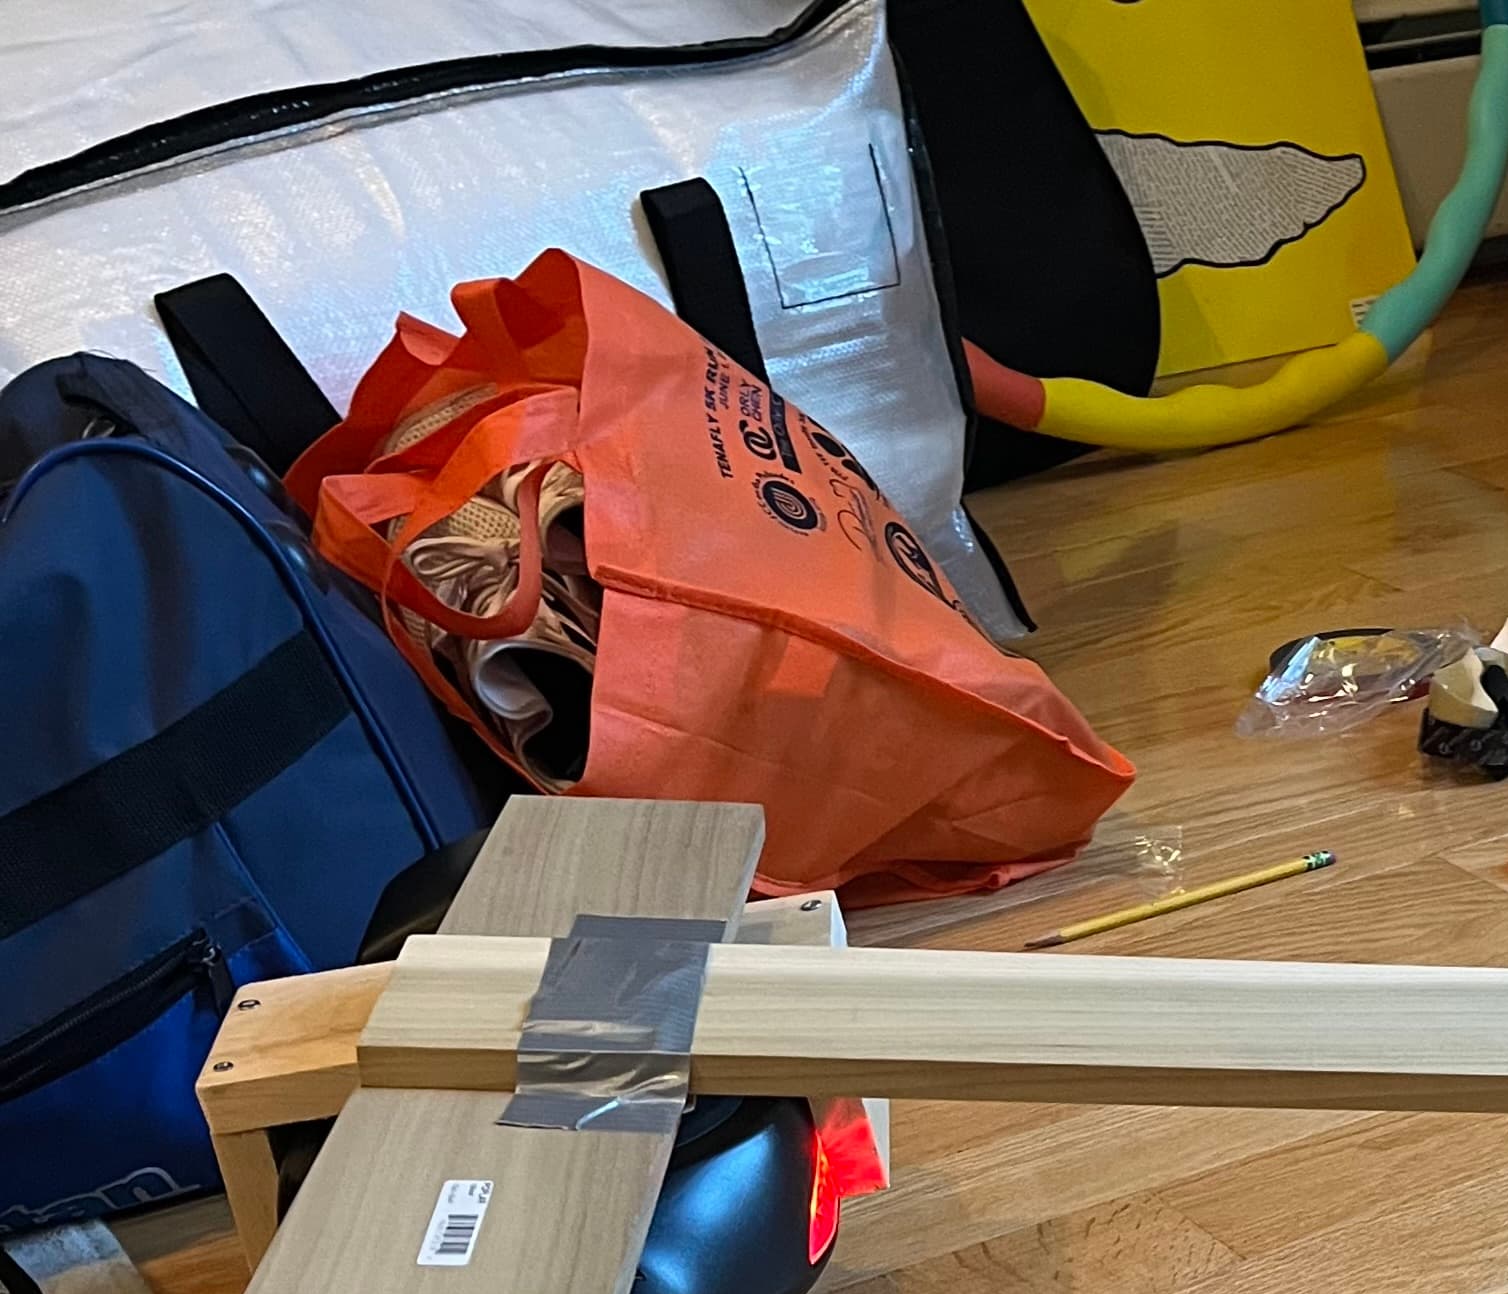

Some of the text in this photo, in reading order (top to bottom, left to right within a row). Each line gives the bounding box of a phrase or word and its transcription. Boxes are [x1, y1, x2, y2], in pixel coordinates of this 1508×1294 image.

[719, 373, 730, 410] JUNE
[739, 378, 750, 417] ORLY
[749, 384, 763, 422] CHEN
[706, 413, 733, 479] TENAFLY
